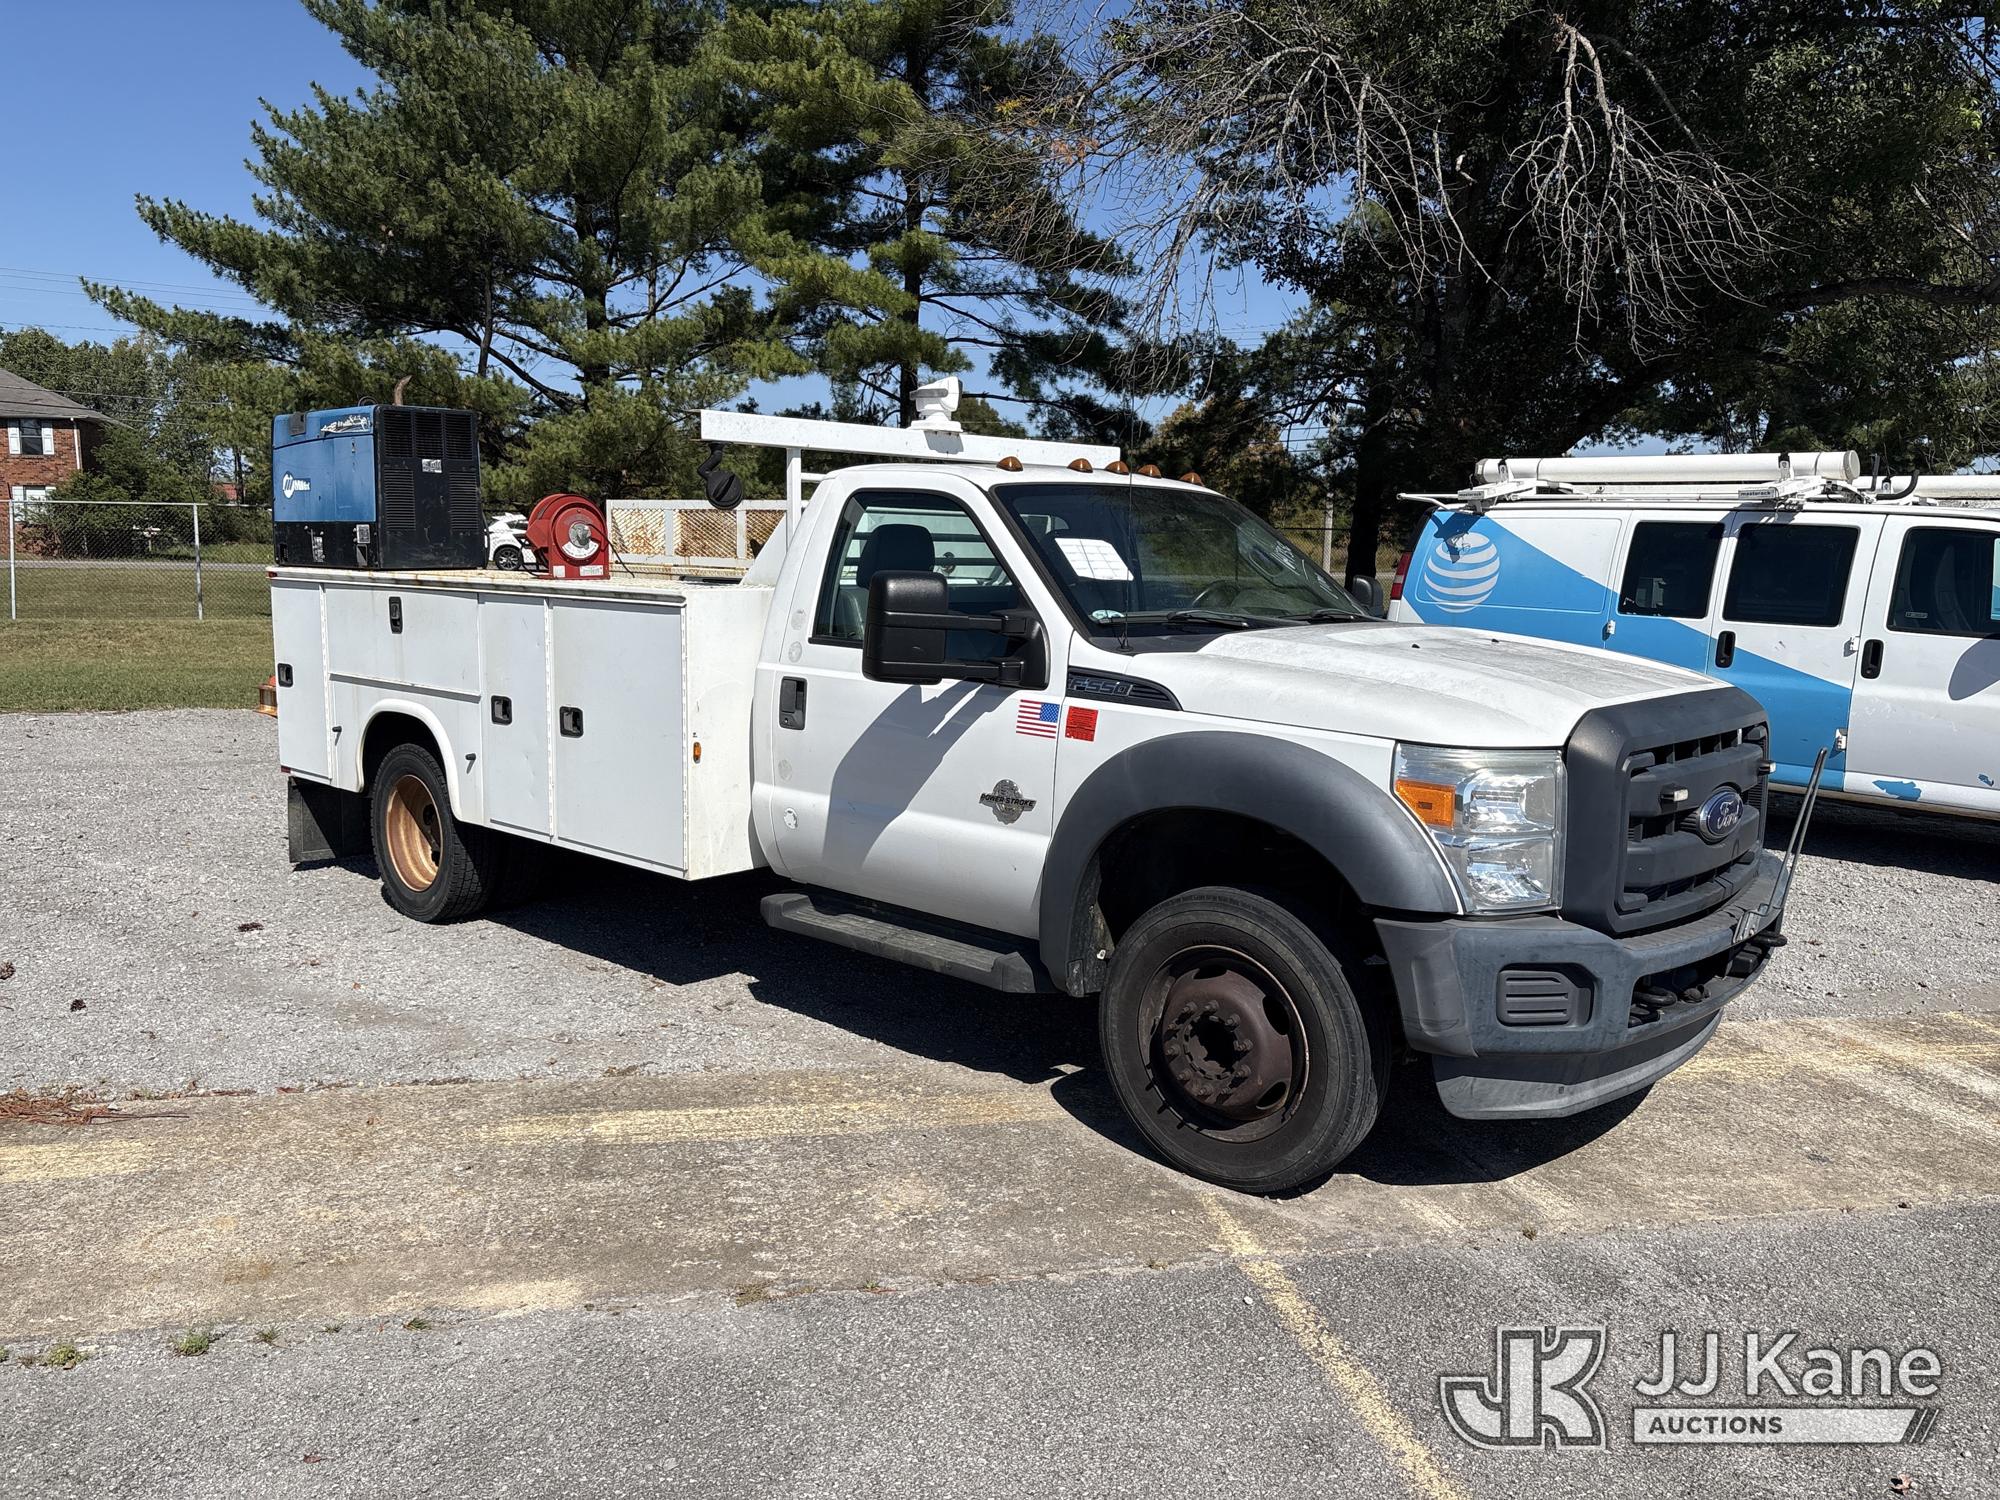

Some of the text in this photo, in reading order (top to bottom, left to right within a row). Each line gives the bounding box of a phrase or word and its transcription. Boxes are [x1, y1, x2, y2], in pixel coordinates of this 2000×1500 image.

[1069, 676, 1133, 697] F-550
[980, 793, 1035, 807] POWER STROKE
[1717, 800, 1740, 830] Ford
